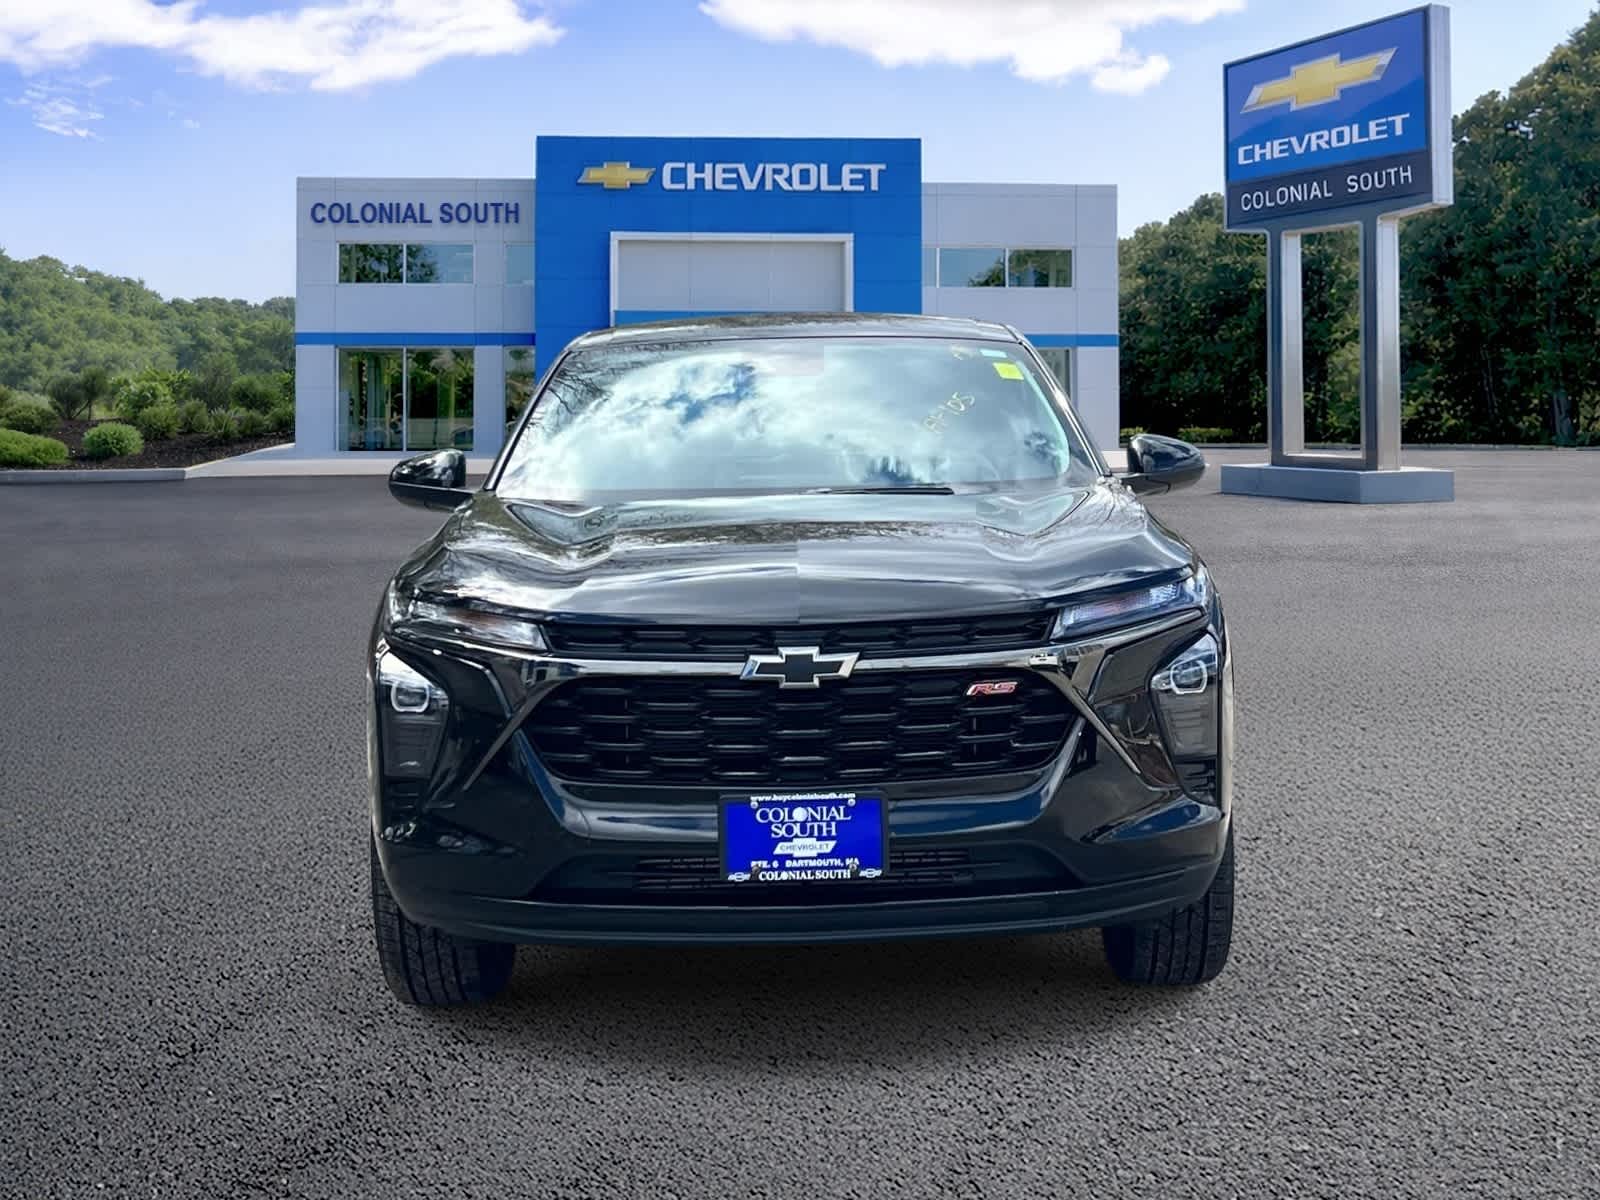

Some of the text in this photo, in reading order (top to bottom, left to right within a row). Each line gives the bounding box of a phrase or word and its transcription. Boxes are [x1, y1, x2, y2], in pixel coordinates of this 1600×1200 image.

[1238, 113, 1410, 164] CHEVROLET
[662, 161, 886, 192] CHEVROLET
[1241, 165, 1412, 211] COLONIAL SOUTH
[310, 202, 520, 224] COLONIAL SOUTH
[966, 681, 1018, 696] RS
[755, 805, 851, 824] COLONIAL
[771, 822, 837, 838] SOUTH
[779, 843, 830, 852] CHEVROLET
[758, 869, 851, 881] COLONIAL SOUTH
